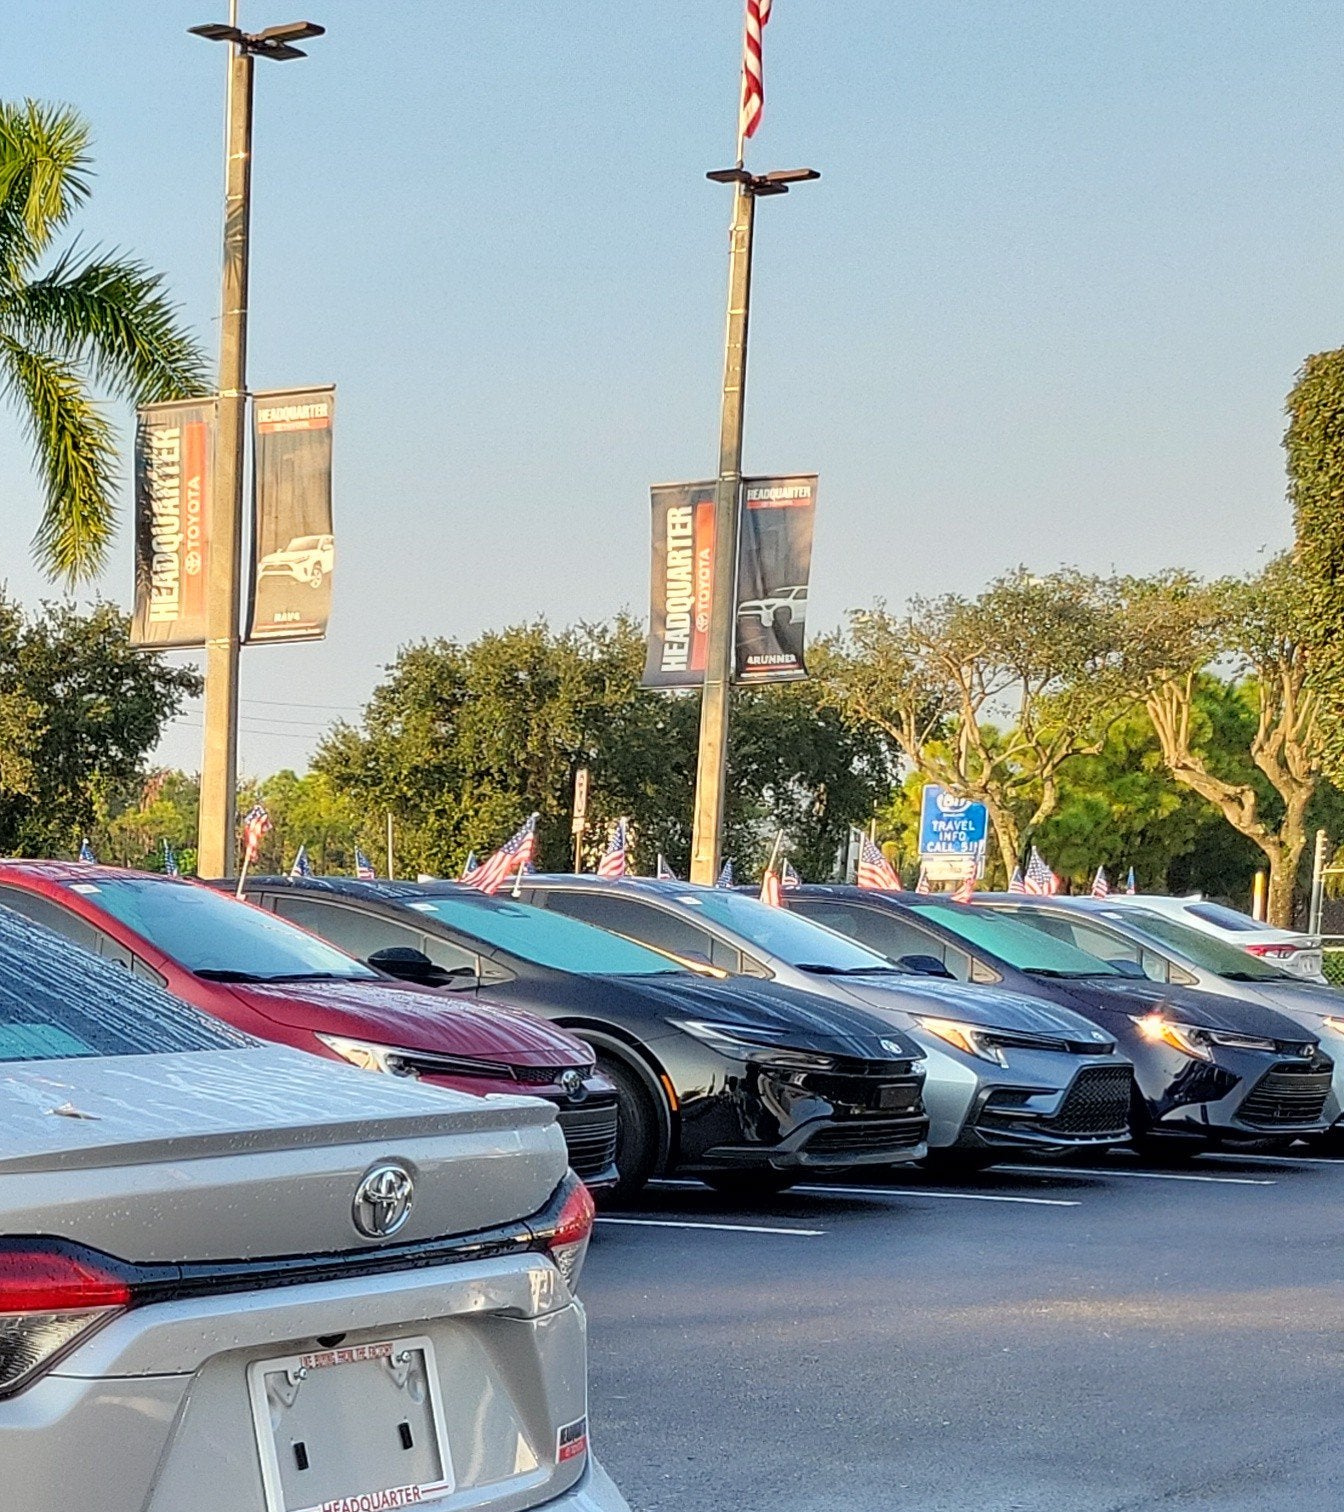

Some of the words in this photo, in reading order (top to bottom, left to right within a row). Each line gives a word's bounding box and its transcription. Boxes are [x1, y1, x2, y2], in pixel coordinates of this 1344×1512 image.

[149, 427, 183, 622] HEADQUARTER
[186, 476, 201, 549] TOYOTA
[661, 505, 695, 672] HEADQUARTER
[698, 548, 711, 609] TOYOTA
[926, 841, 954, 852] CALL
[932, 820, 976, 832] TRAVEL
